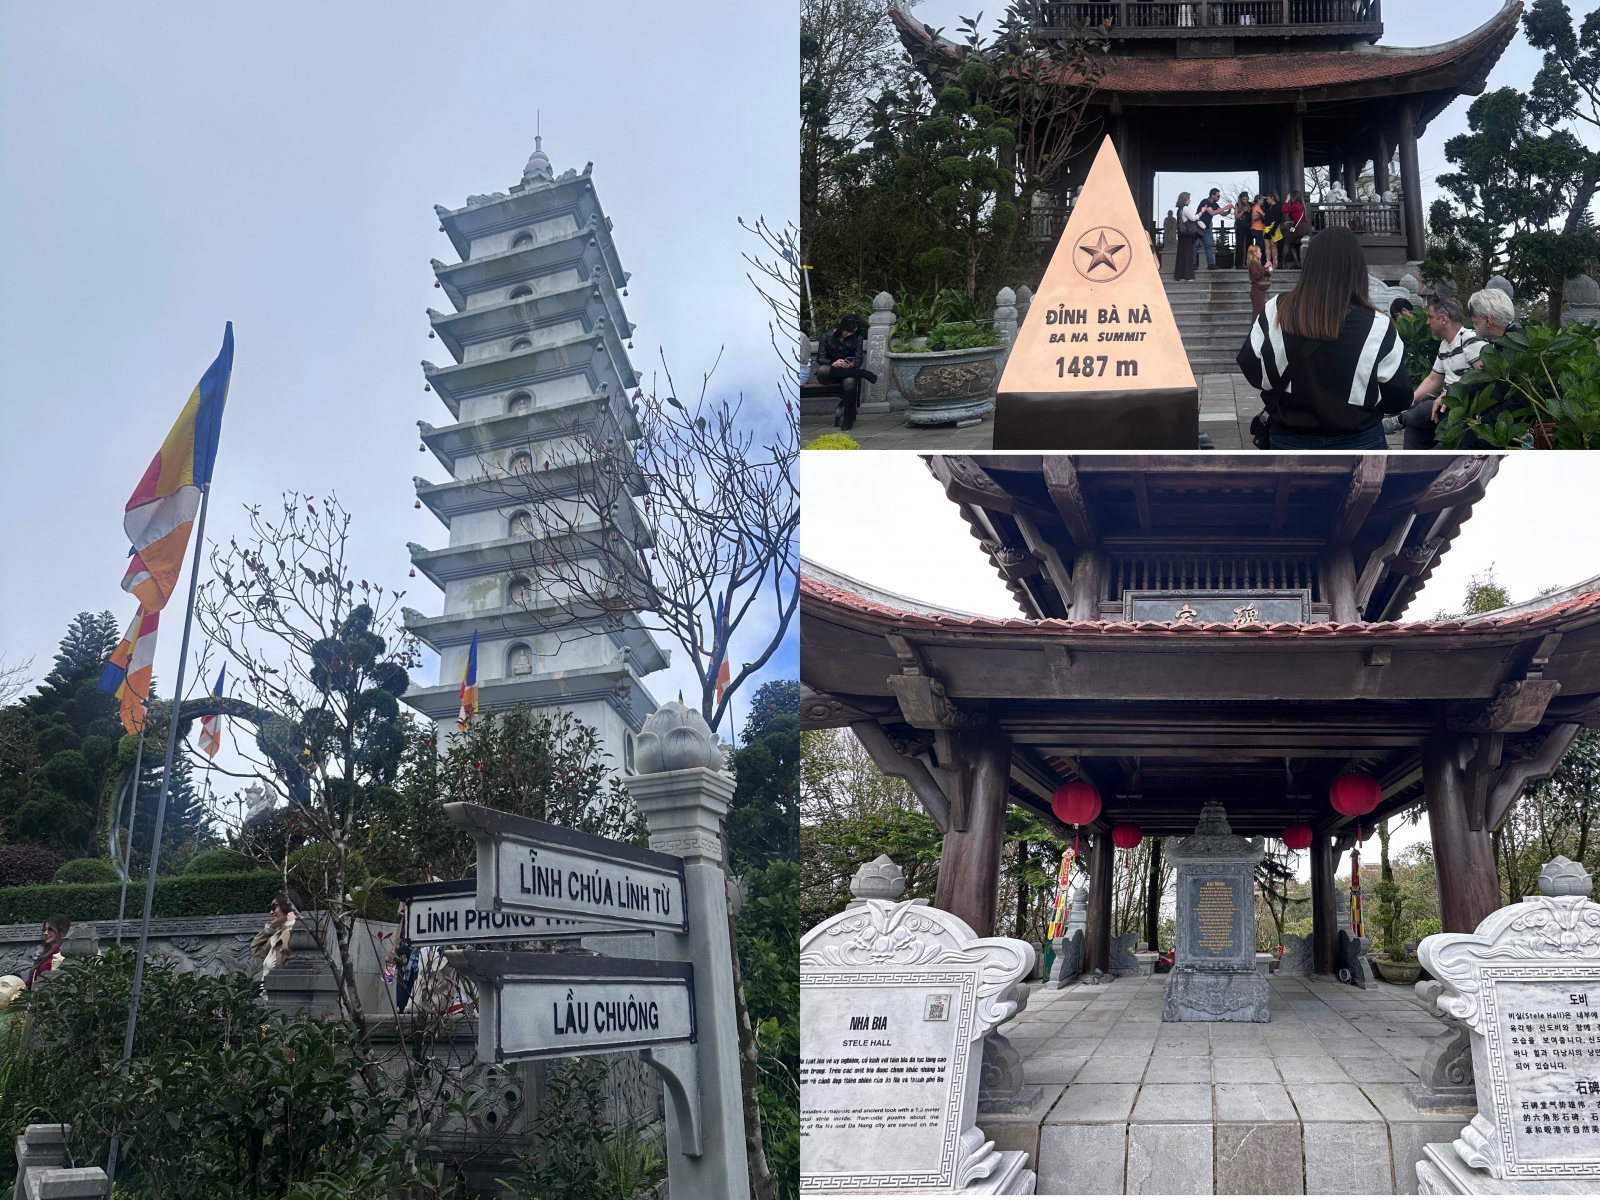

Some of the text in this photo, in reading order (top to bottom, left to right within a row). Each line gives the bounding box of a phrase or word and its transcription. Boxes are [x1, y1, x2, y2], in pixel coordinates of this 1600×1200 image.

[1045, 303, 1152, 325] ĐỈNH BÀ NÀ
[1048, 332, 1147, 344] BA NA SUMMIT
[1056, 356, 1138, 378] 1487 m
[568, 869, 614, 906] CHÚA
[652, 882, 670, 916] TỪ
[554, 988, 659, 1034] LẦU CHUÔNG
[872, 1016, 888, 1031] BIA
[1513, 1049, 1528, 1058] 바나
